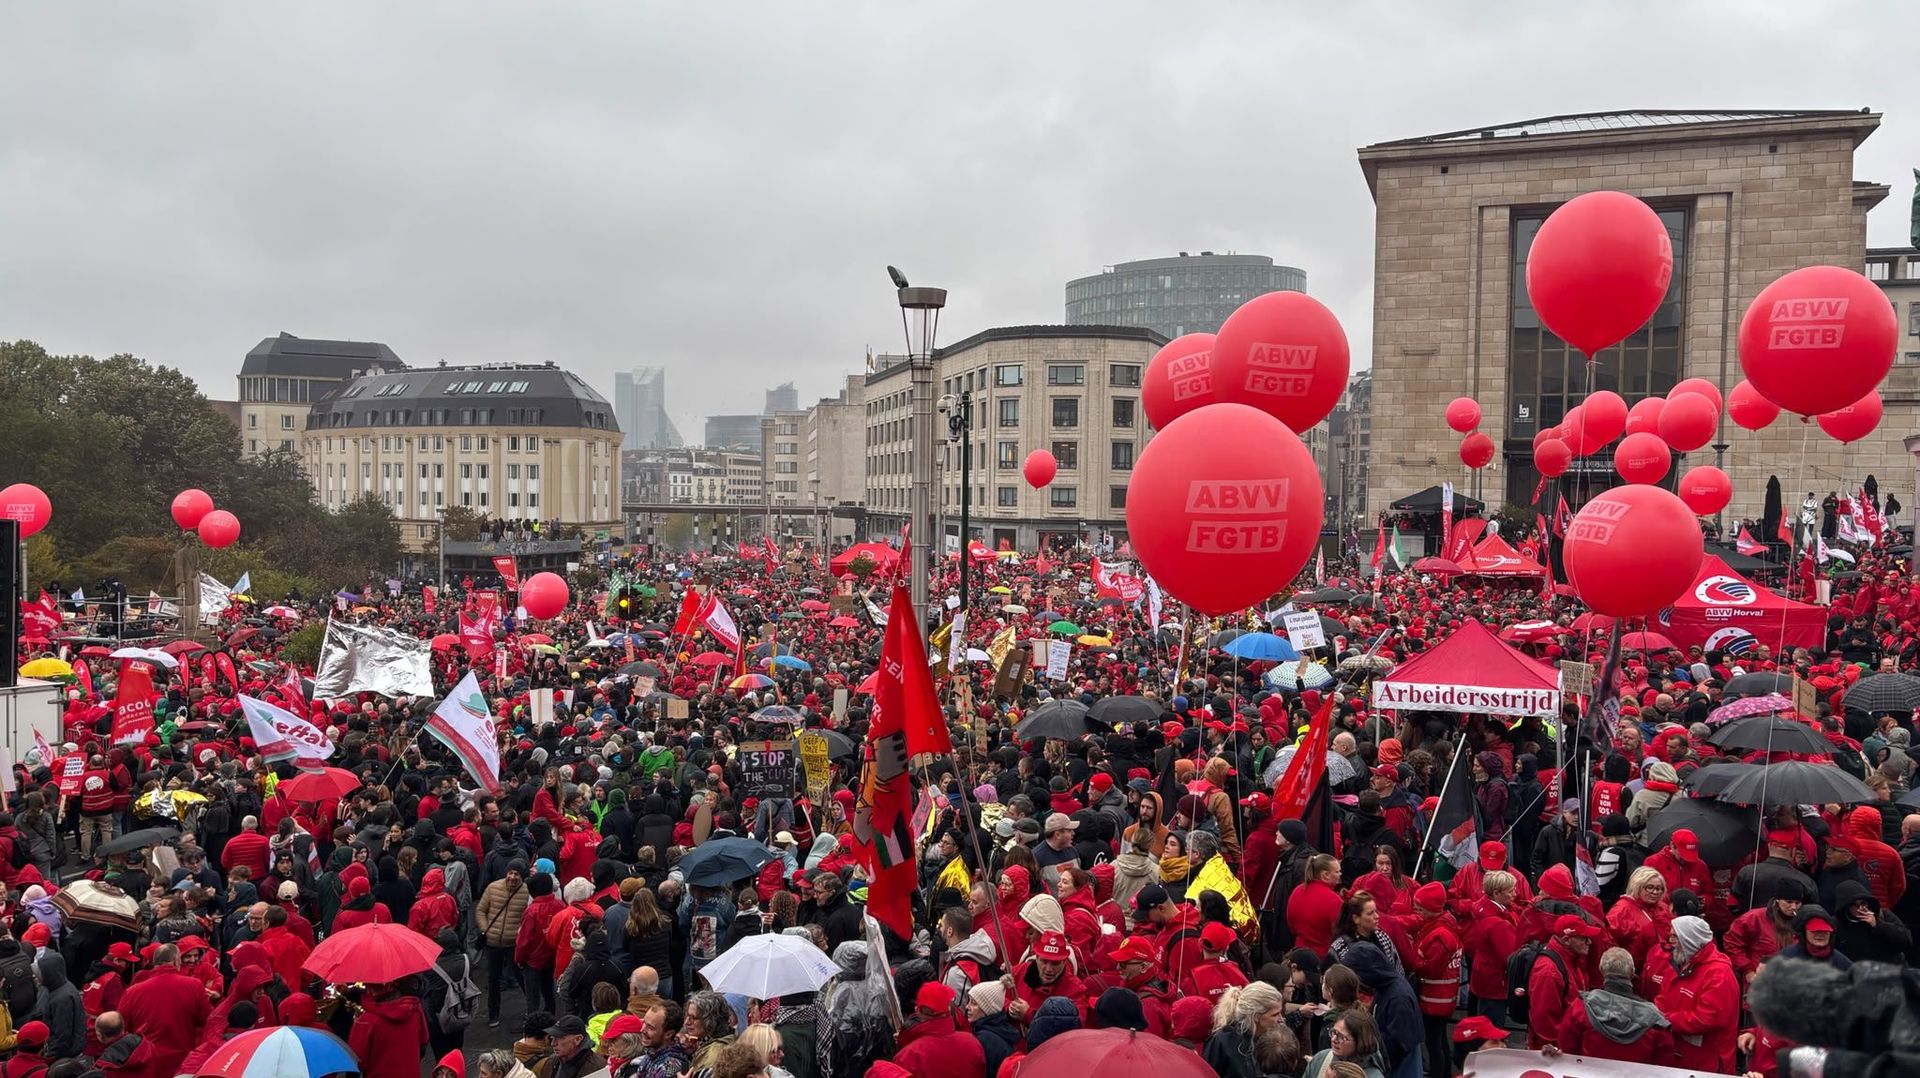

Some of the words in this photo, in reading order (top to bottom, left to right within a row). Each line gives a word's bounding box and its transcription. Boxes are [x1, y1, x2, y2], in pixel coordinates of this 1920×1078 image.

[1774, 300, 1842, 319] ABVV
[1773, 328, 1838, 347] FGTB
[1172, 352, 1210, 376] ABV
[1252, 346, 1312, 366] ABVV
[1179, 376, 1210, 398] FGT
[1250, 373, 1306, 393] FGTB
[1193, 484, 1281, 510] ABVV
[1583, 501, 1625, 517] BVV
[1195, 525, 1280, 550] FGTB
[1733, 609, 1764, 617] Horval
[1378, 683, 1553, 714] Arbeidersstrijd
[803, 737, 819, 745] GEEF
[751, 751, 786, 766] STOP
[743, 771, 765, 782] THE
